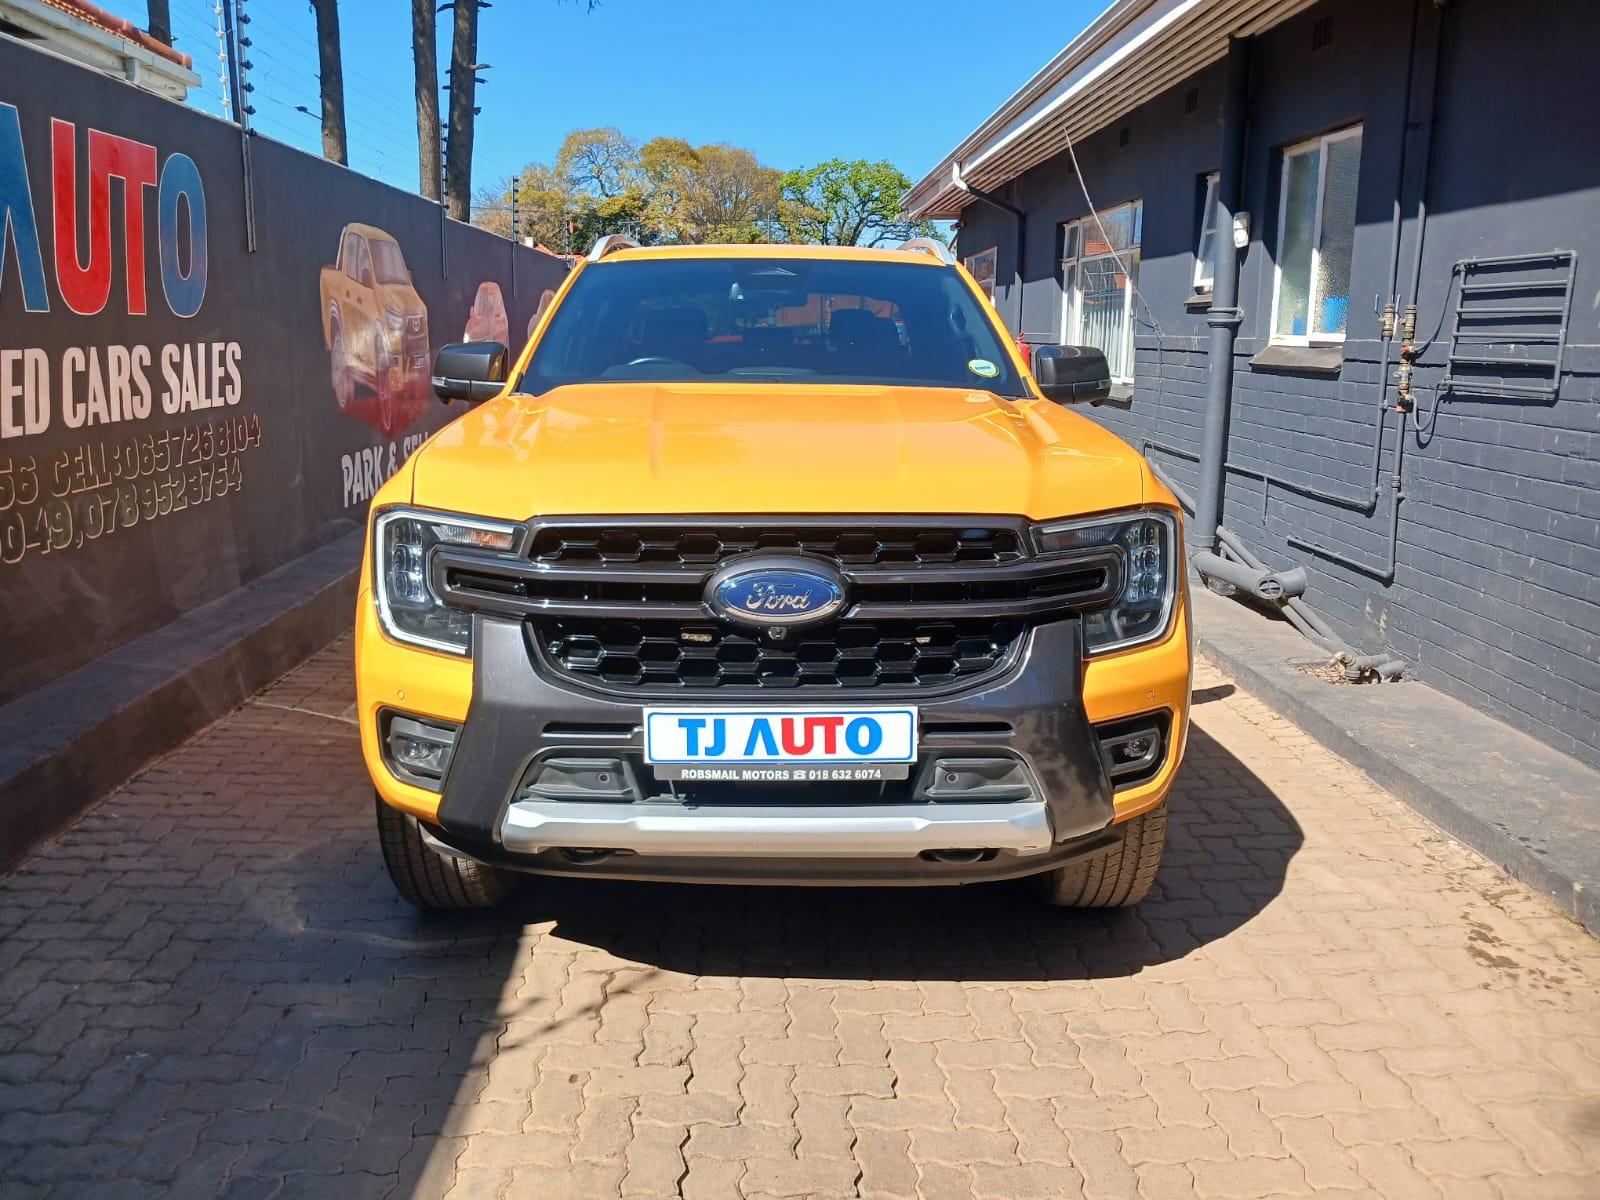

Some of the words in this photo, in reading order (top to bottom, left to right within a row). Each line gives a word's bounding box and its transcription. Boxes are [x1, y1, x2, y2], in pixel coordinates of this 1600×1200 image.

[62, 344, 152, 429] CARS
[161, 341, 242, 415] SALES
[341, 445, 384, 508] PARK
[746, 583, 812, 609] Ford
[678, 718, 726, 757] TJ
[743, 716, 883, 757] AUTO
[681, 769, 739, 780] ROBSMAIL
[742, 769, 790, 780] MOTORS
[809, 769, 829, 780] 018
[831, 769, 852, 780] 632
[854, 769, 882, 779] 6074
